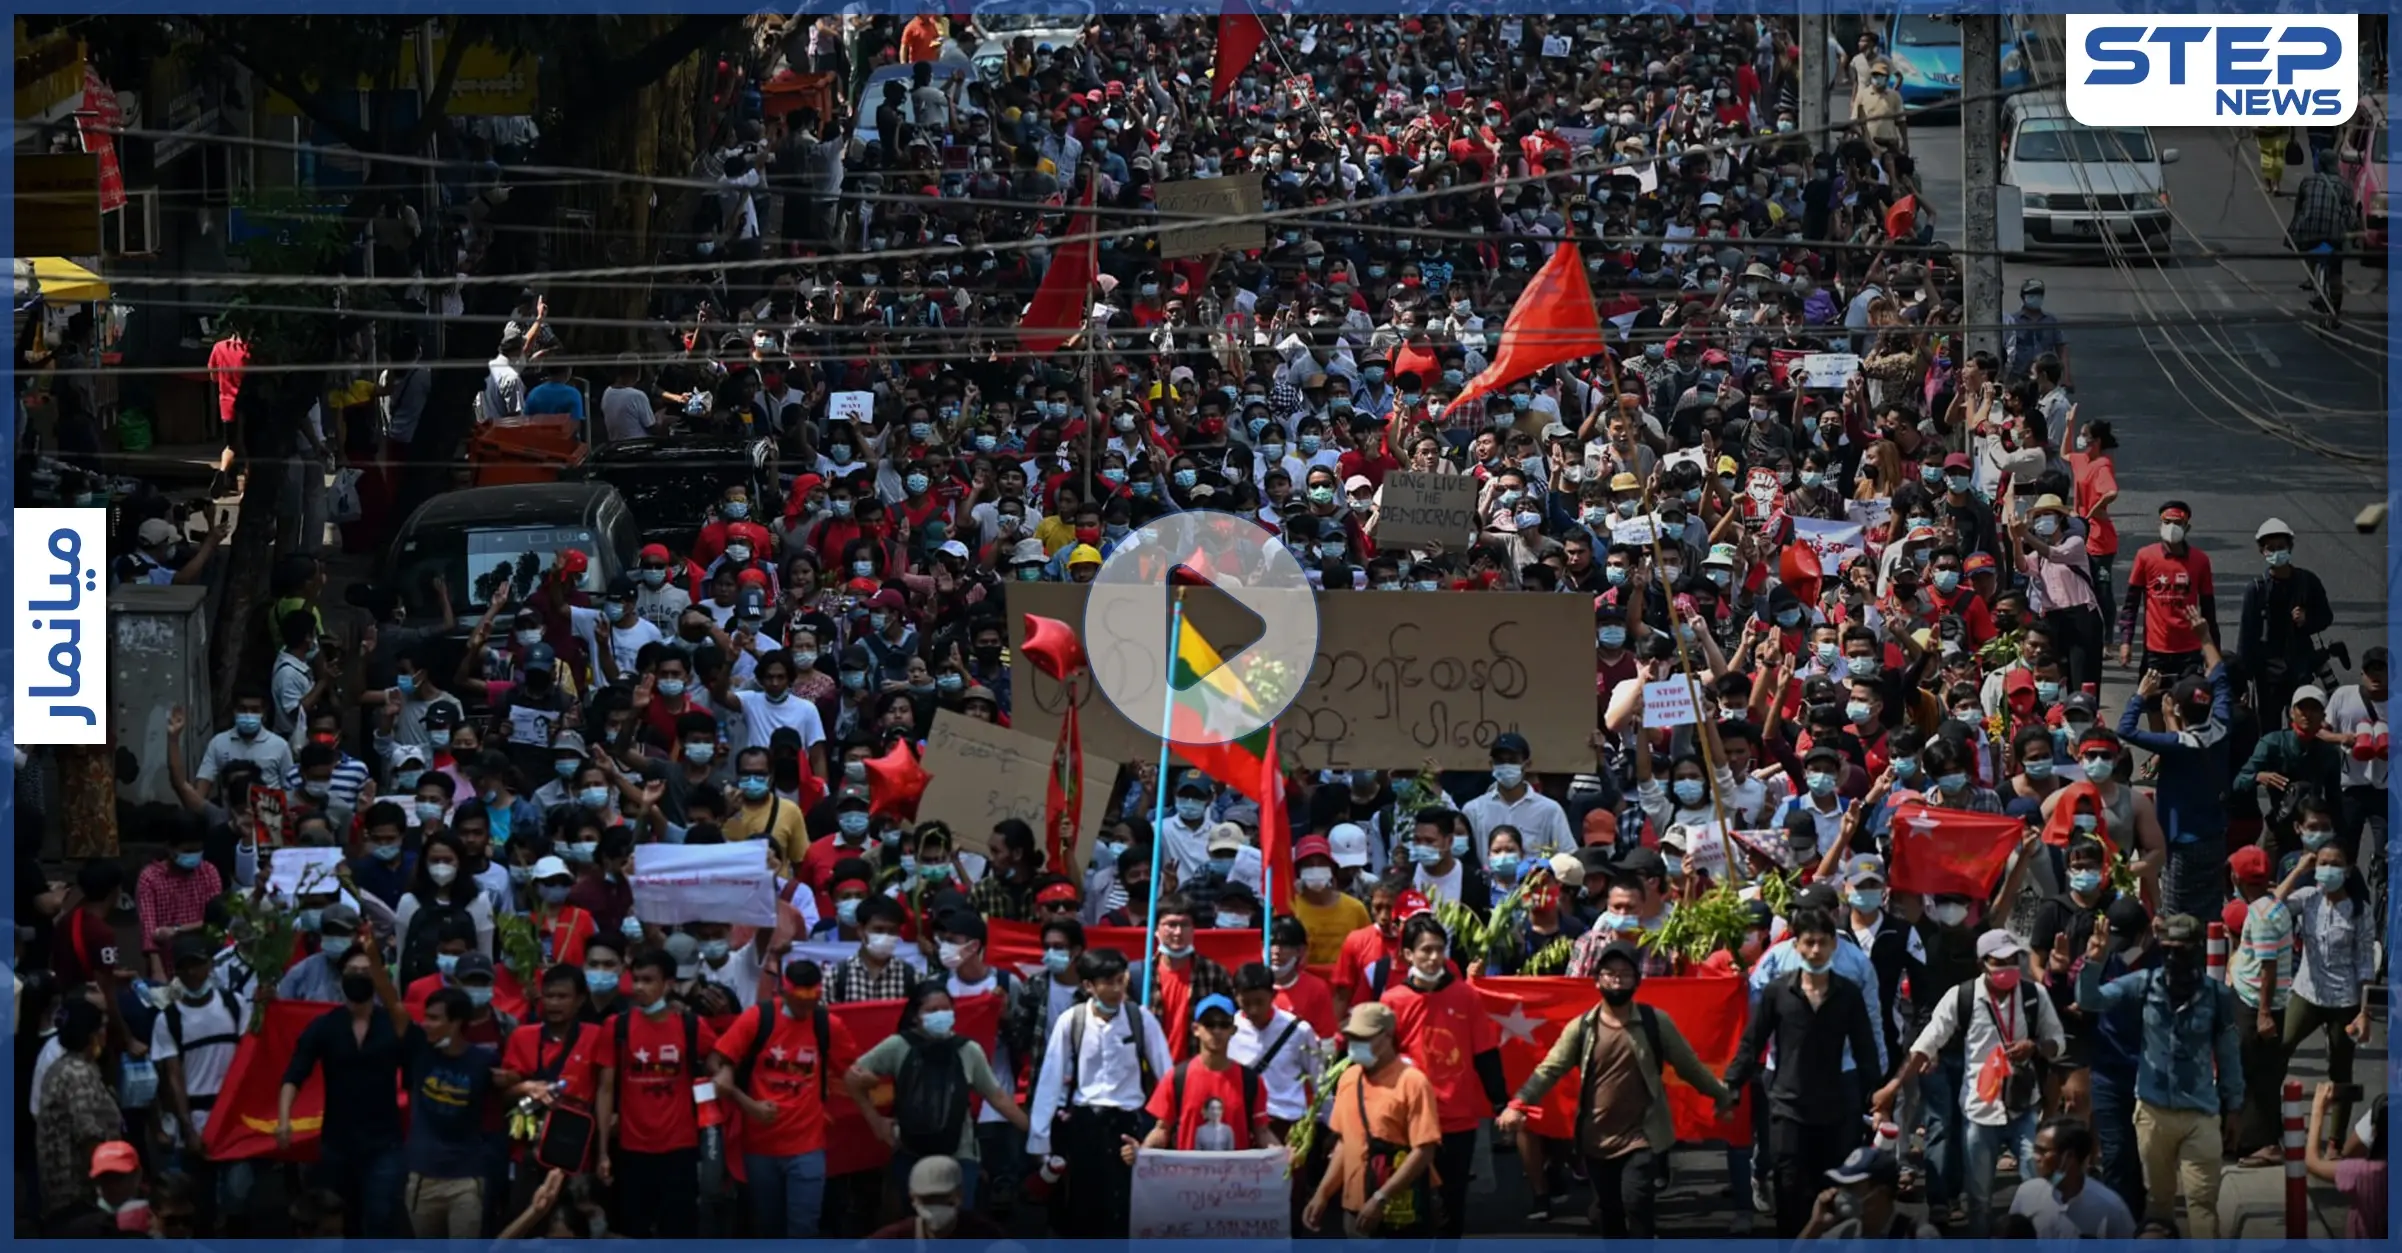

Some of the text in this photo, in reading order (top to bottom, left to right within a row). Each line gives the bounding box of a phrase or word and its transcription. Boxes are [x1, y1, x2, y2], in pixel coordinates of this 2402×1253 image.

[1391, 473, 1468, 491] LONG LIVE
[1415, 490, 1442, 505] THE
[1380, 505, 1474, 530] DEMOCRACY
[1656, 687, 1685, 696] STOP
[1648, 699, 1691, 709] MILITAR
[1658, 710, 1685, 719] COUP
